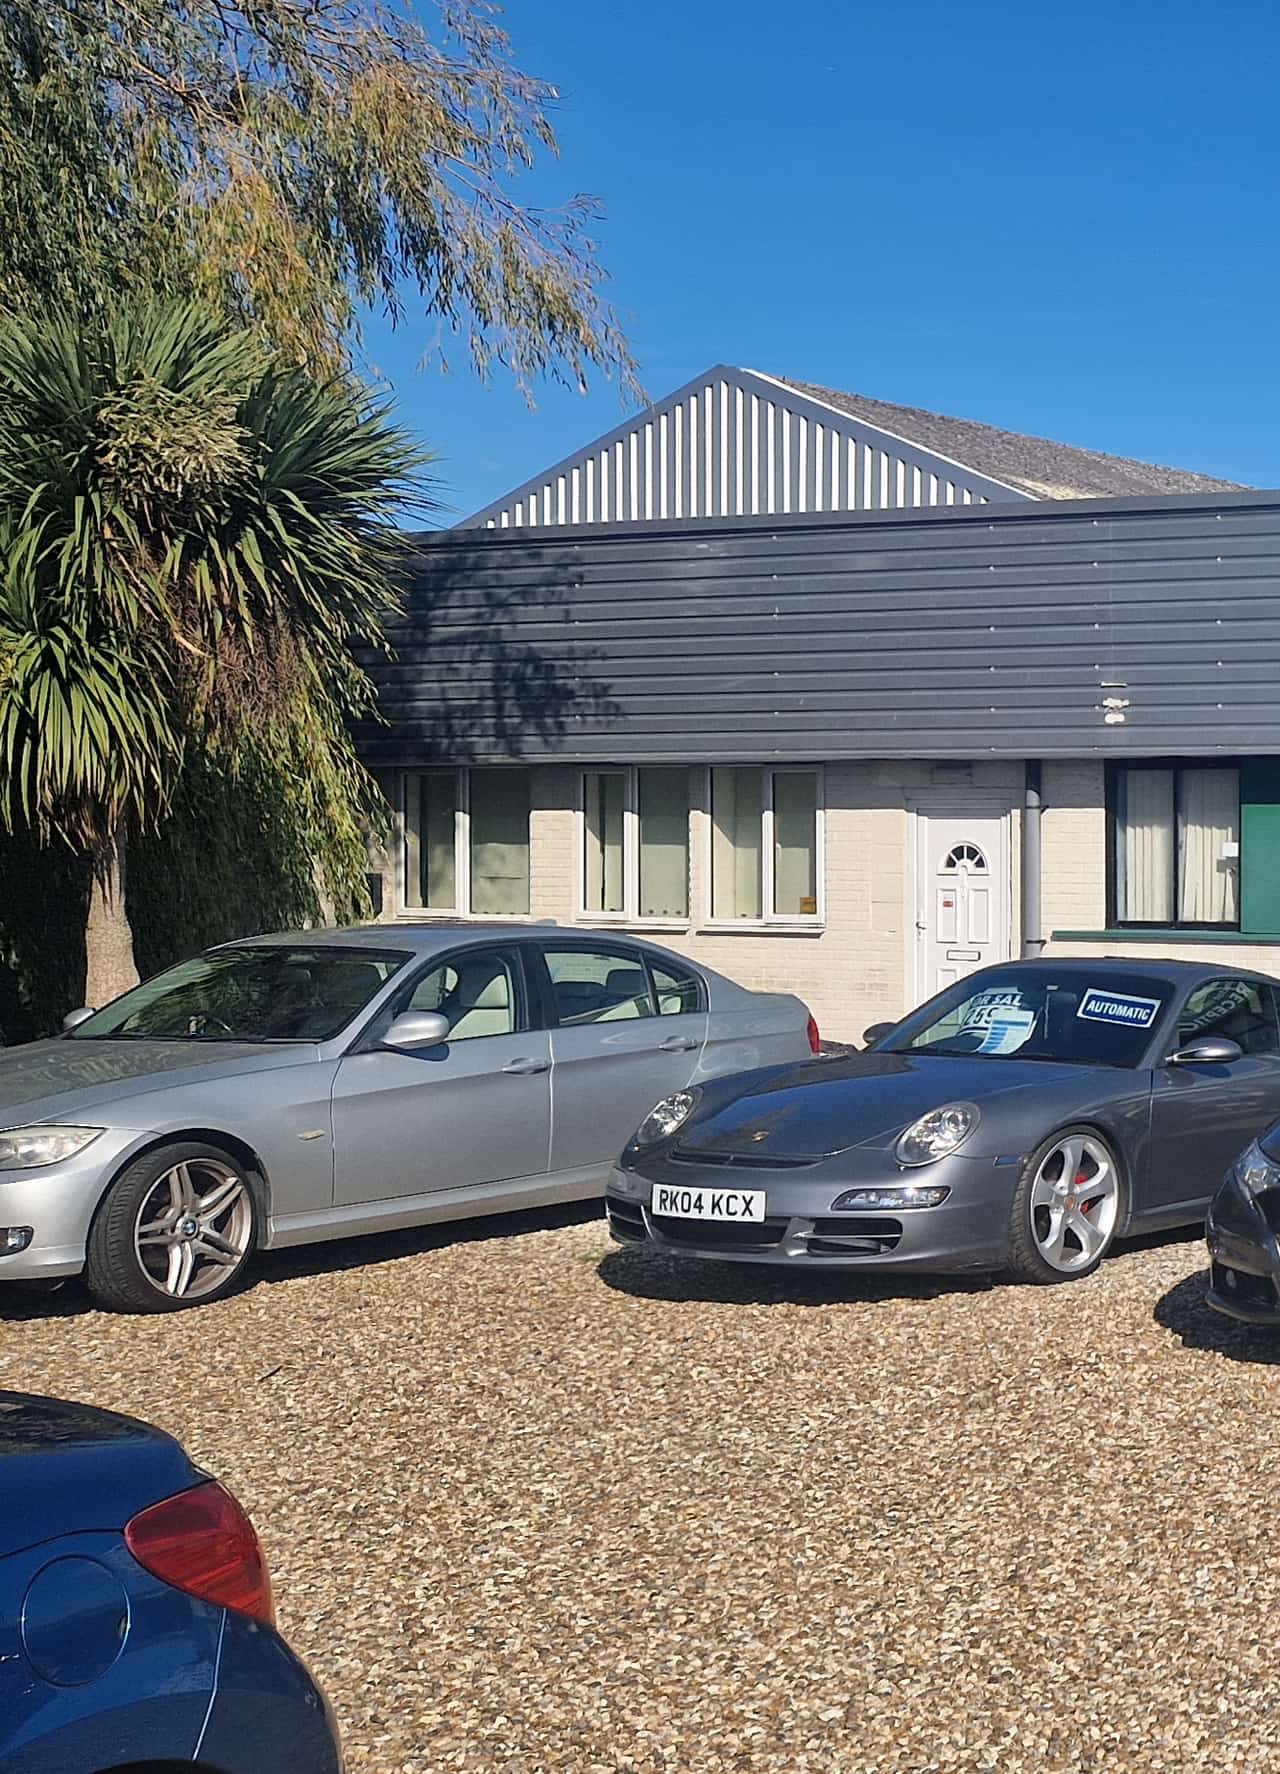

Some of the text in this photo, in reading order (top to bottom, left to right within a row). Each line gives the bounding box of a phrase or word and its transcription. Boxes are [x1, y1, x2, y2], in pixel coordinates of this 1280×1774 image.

[992, 995, 1022, 1006] SAL
[1087, 1001, 1151, 1020] AUTOMATIC
[659, 1189, 754, 1217] RK04 KCX
